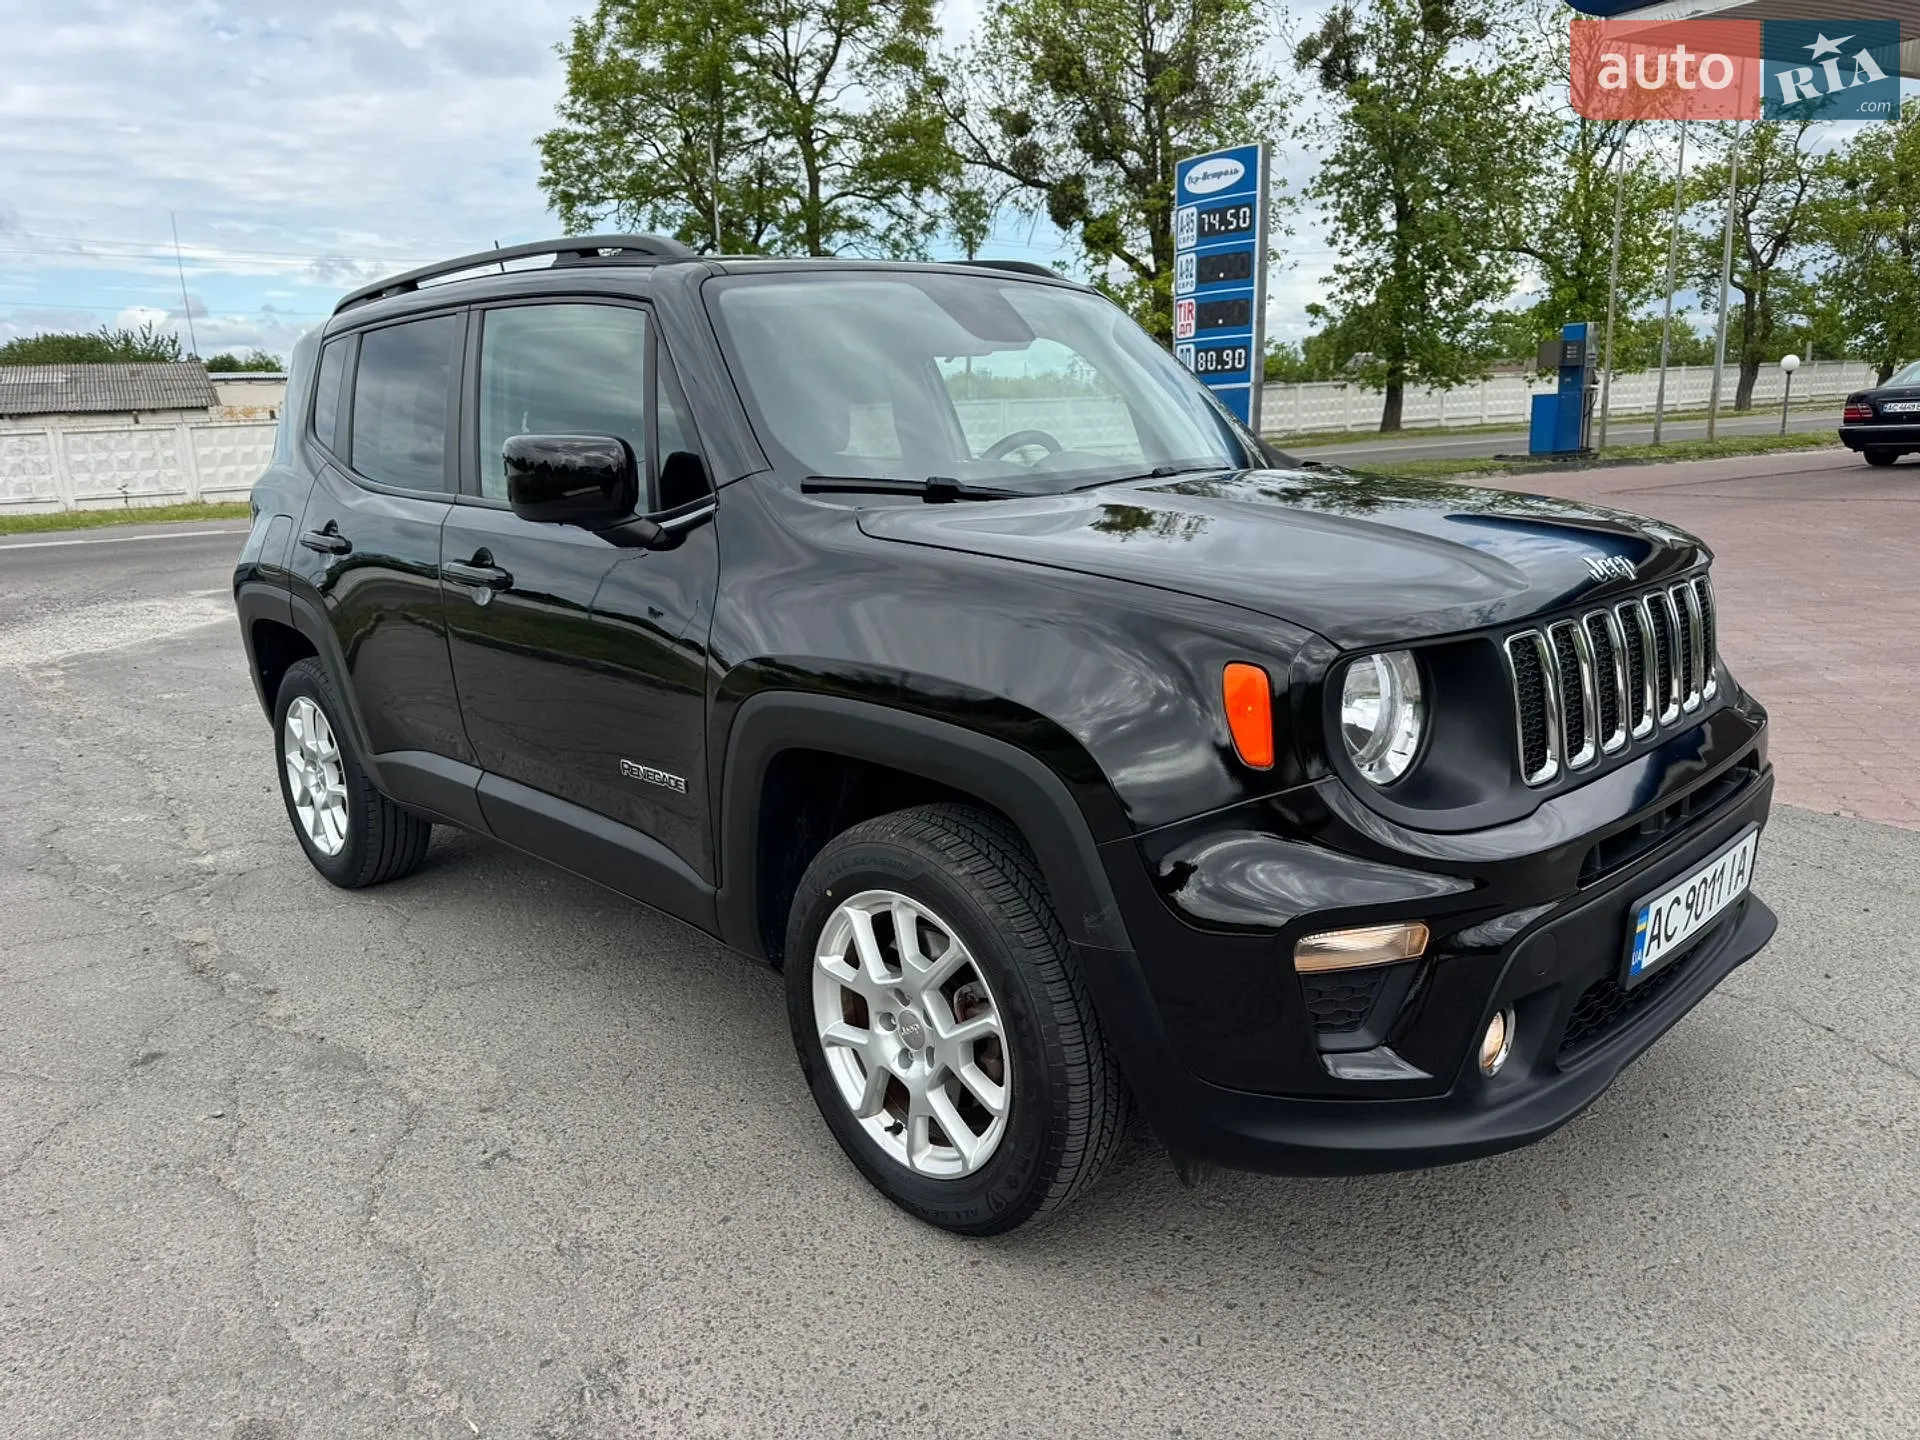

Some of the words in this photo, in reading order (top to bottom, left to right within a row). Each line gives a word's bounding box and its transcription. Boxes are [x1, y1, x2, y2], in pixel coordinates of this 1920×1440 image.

[1201, 207, 1250, 232] 74.50
[1177, 302, 1194, 322] TIR
[1197, 348, 1246, 371] 80.90
[620, 759, 687, 794] RENEGADE
[1645, 895, 1681, 958] AC
